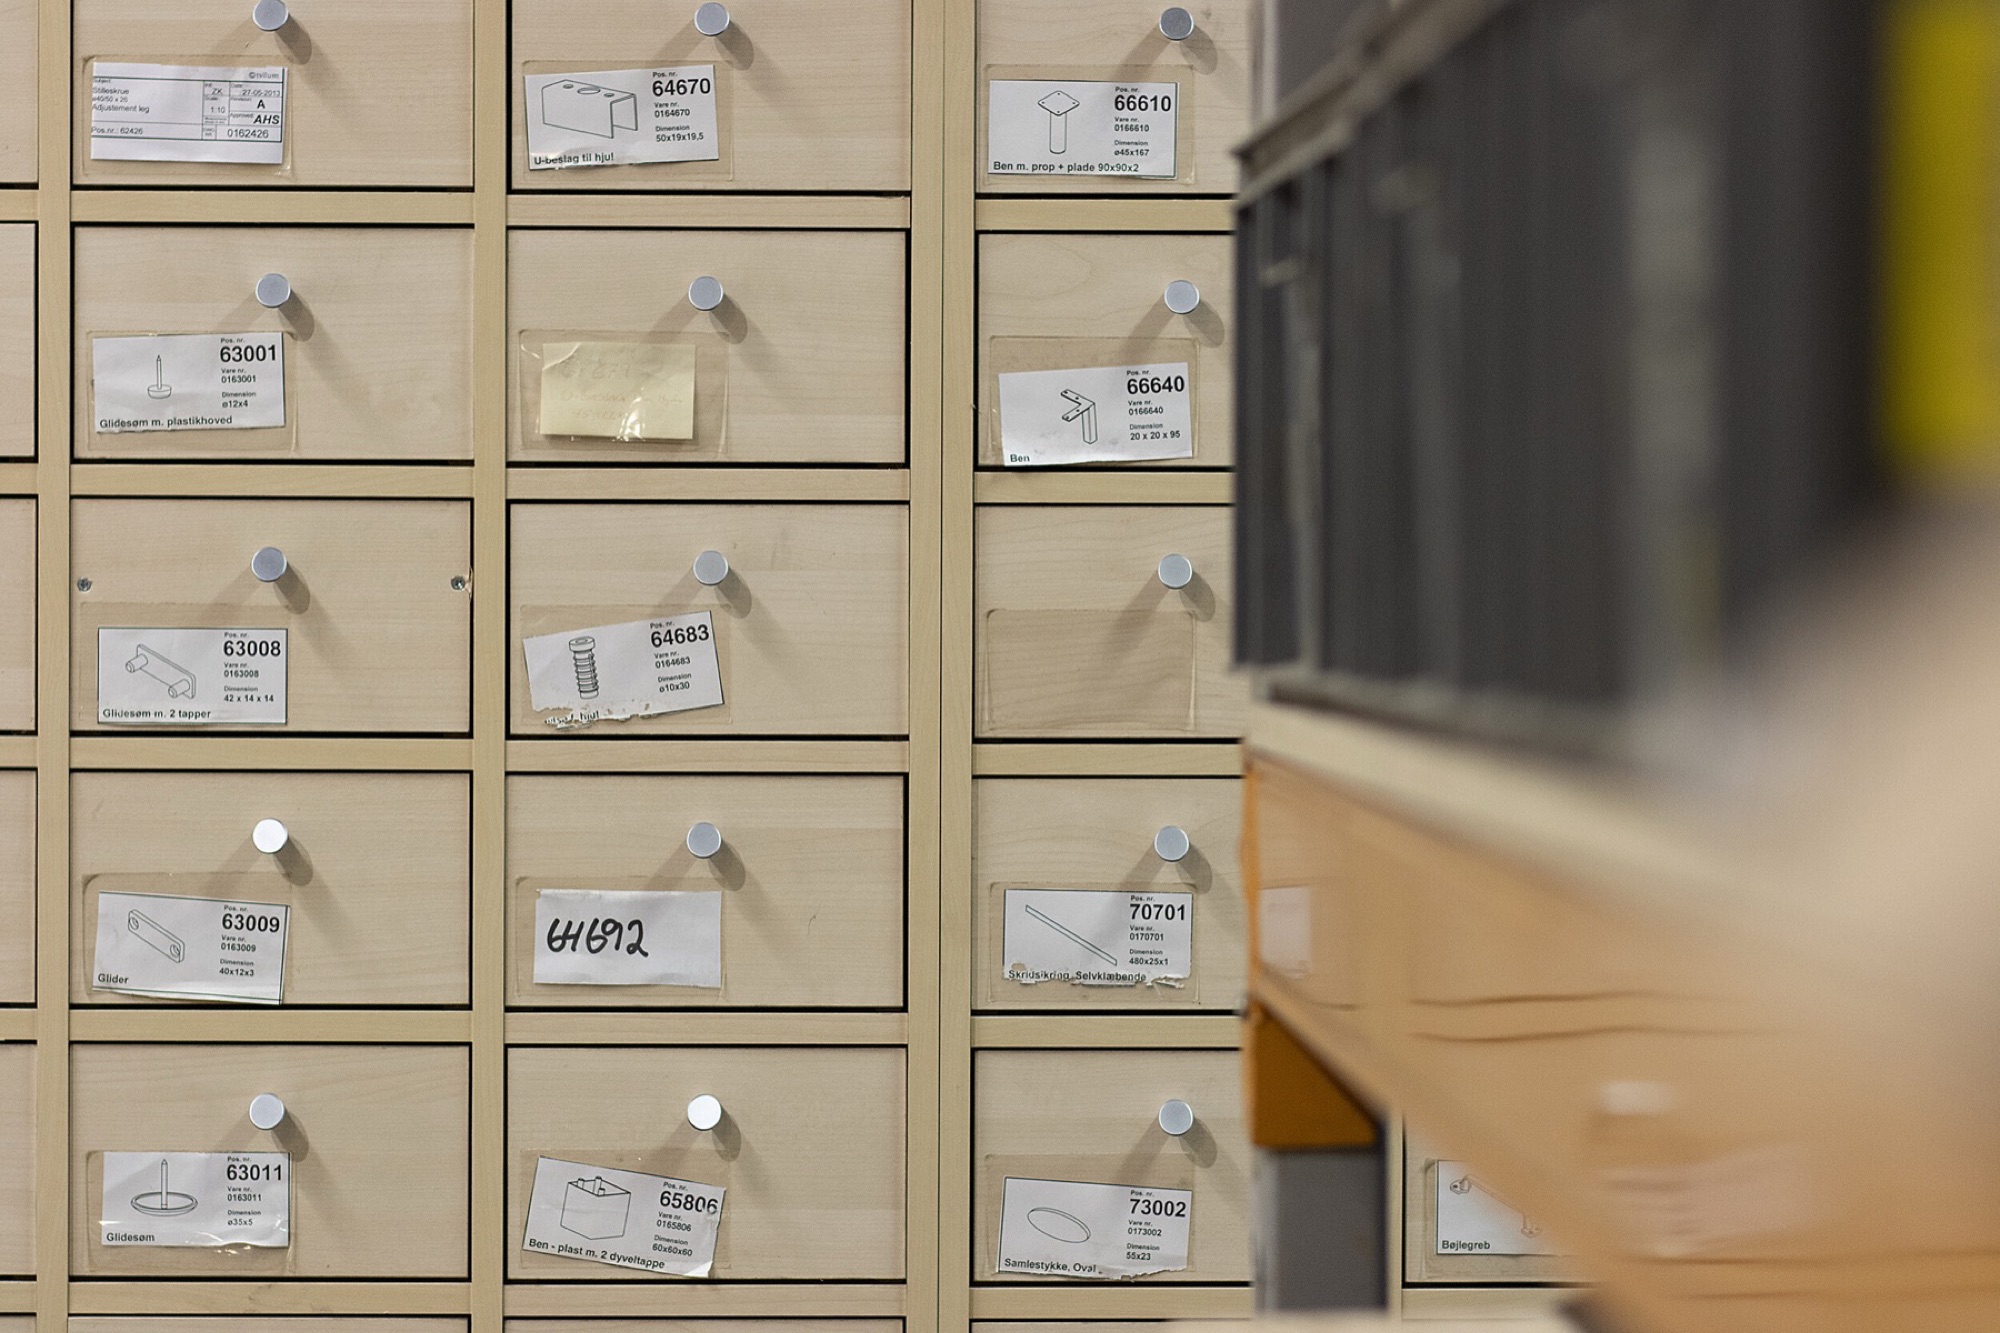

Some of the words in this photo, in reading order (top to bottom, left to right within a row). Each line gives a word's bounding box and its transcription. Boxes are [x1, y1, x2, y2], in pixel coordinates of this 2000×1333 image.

[652, 78, 711, 97] 64670
[257, 99, 266, 109] A
[1114, 95, 1171, 112] 66610
[138, 105, 150, 114] leg
[654, 109, 690, 118] 0164670
[253, 114, 280, 124] AHS
[655, 124, 690, 132] Dimension
[1114, 124, 1150, 132] 0166610
[227, 128, 269, 139] 0162426
[656, 132, 704, 142] 50x19x19,5
[582, 153, 592, 162] til
[1114, 149, 1150, 157] ø45x167
[993, 161, 1013, 171] Ben
[1016, 163, 1029, 171] m.
[1032, 163, 1055, 173] prop
[1067, 163, 1095, 173] plade
[1098, 164, 1139, 173] 90x90x2
[220, 345, 276, 362] 63001
[221, 375, 256, 383] 0163001
[1127, 375, 1185, 395] 66640
[222, 400, 249, 408] ø12x4
[1128, 407, 1164, 416] 0166640
[100, 418, 148, 429] Glidesøm
[151, 419, 164, 427] m.
[167, 416, 233, 427] plastikhoved
[1130, 432, 1141, 441] 20
[1150, 431, 1161, 440] 20
[1170, 430, 1180, 439] 95
[1010, 453, 1030, 463] Ben
[651, 624, 710, 648] 64683
[223, 640, 281, 657] 63008
[654, 652, 669, 660] Vare
[655, 657, 691, 669] 0164683
[224, 670, 259, 678] 0163008
[657, 672, 692, 683] Dimension
[659, 681, 690, 693] ø10x30
[154, 710, 166, 718] m.
[170, 709, 176, 718] 2
[178, 709, 211, 720] tapper
[1130, 904, 1186, 921] 70701
[222, 913, 280, 933] 63009
[547, 917, 649, 958] 64692
[1129, 932, 1164, 941] 0170701
[220, 943, 256, 952] 0163009
[220, 958, 254, 967] Dimension
[219, 967, 255, 977] 40x12x3
[98, 973, 129, 984] Glider
[227, 1164, 282, 1181] 63011
[663, 1181, 677, 1190] Pos.
[228, 1193, 262, 1202] 0163011
[659, 1190, 718, 1215] 65806
[1130, 1199, 1186, 1217] 73002
[658, 1211, 673, 1219] Vare
[228, 1218, 253, 1226] ø35x5
[656, 1219, 692, 1232] 0165806
[106, 1232, 155, 1242] Glidesøm
[1127, 1228, 1162, 1236] 0173002
[653, 1234, 689, 1246] Dimension
[652, 1243, 693, 1257] 60x60x60
[1127, 1243, 1160, 1251] Dimension
[1441, 1240, 1491, 1251] Bøjlegreb
[529, 1239, 549, 1250] Ben
[557, 1244, 583, 1256] plast
[585, 1248, 598, 1258] m.
[600, 1250, 607, 1259] 2
[609, 1251, 665, 1269] dyveltappe
[1126, 1252, 1151, 1261] 55x23
[1004, 1258, 1071, 1272] Samlestykke,
[1073, 1262, 1097, 1273] Oval
